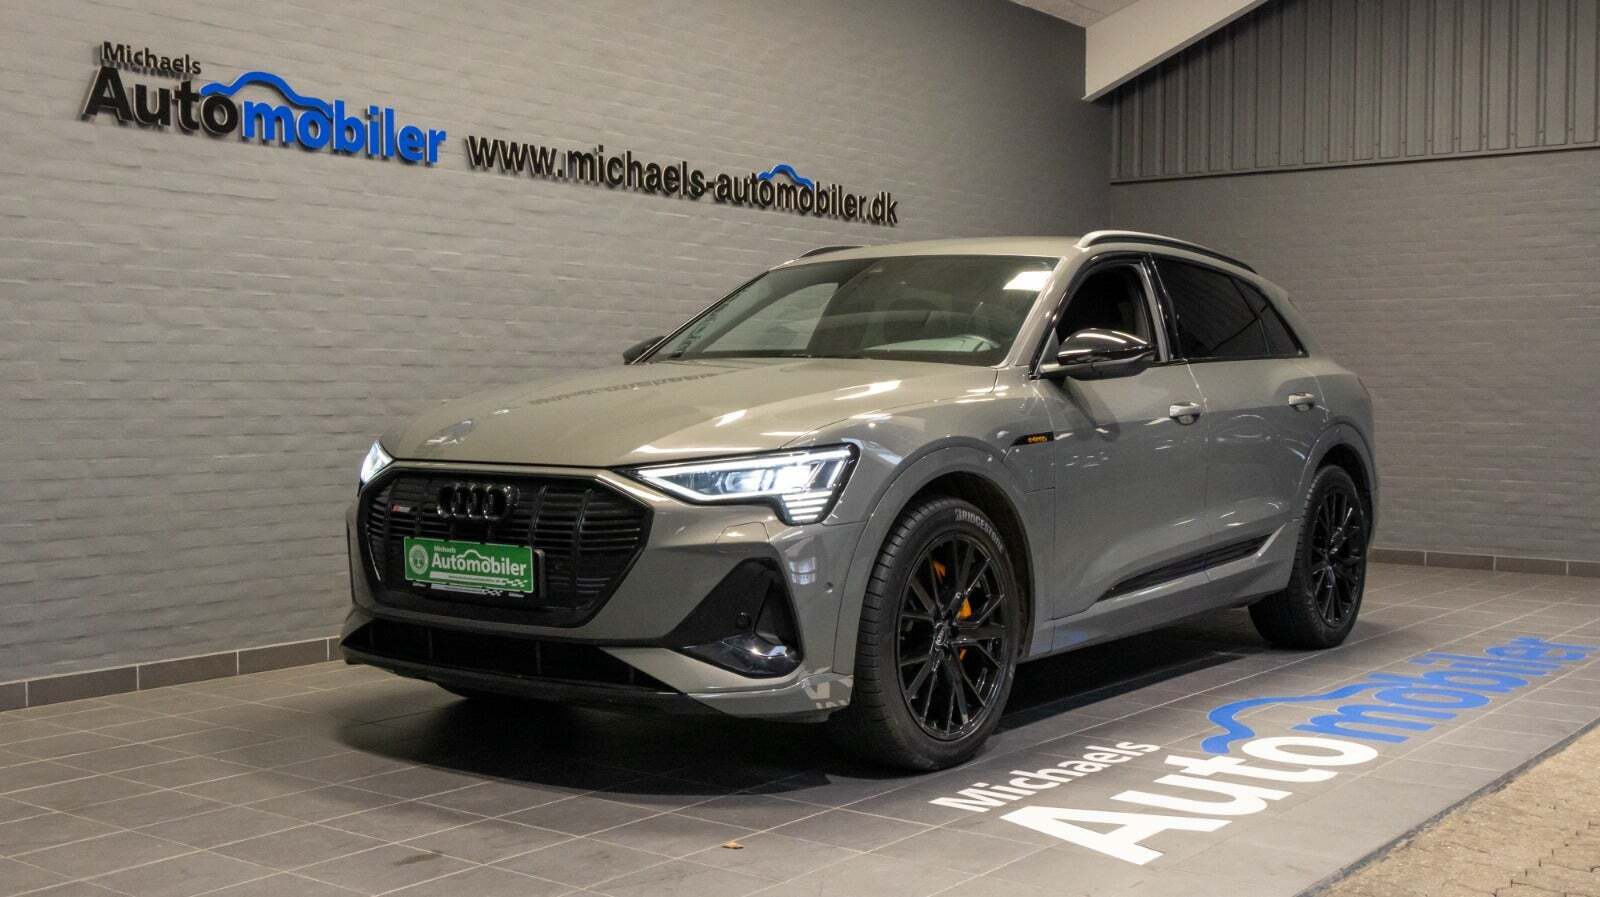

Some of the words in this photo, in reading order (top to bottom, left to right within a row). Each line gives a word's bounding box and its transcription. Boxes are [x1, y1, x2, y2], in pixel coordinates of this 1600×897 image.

[101, 41, 202, 75] Michaels
[82, 65, 447, 166] Automobiler
[466, 134, 898, 226] www.michaels-automobiler.dk
[431, 552, 527, 576] Automobiler
[928, 741, 1161, 813] Michaels
[1001, 636, 1599, 865] Automobiler
